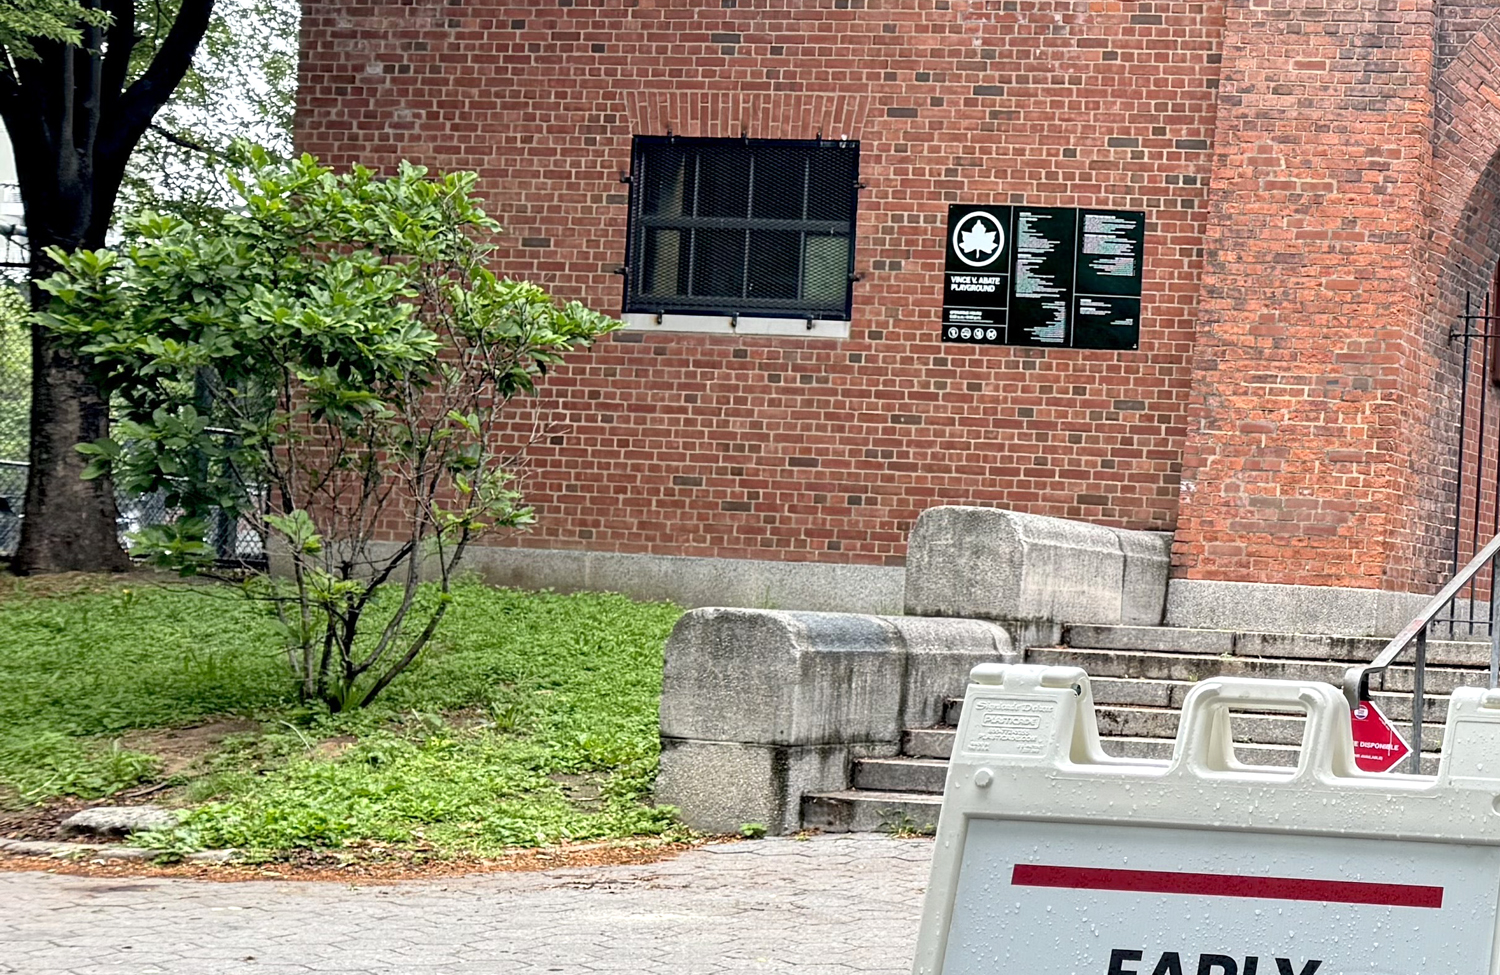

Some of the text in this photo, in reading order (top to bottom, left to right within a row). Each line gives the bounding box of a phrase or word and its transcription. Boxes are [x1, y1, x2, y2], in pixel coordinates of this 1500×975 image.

[951, 276, 971, 284] VINCE
[979, 277, 1000, 285] ABATE
[951, 284, 995, 292] PLAYGROUND
[1360, 741, 1399, 751] DISPONIBLE
